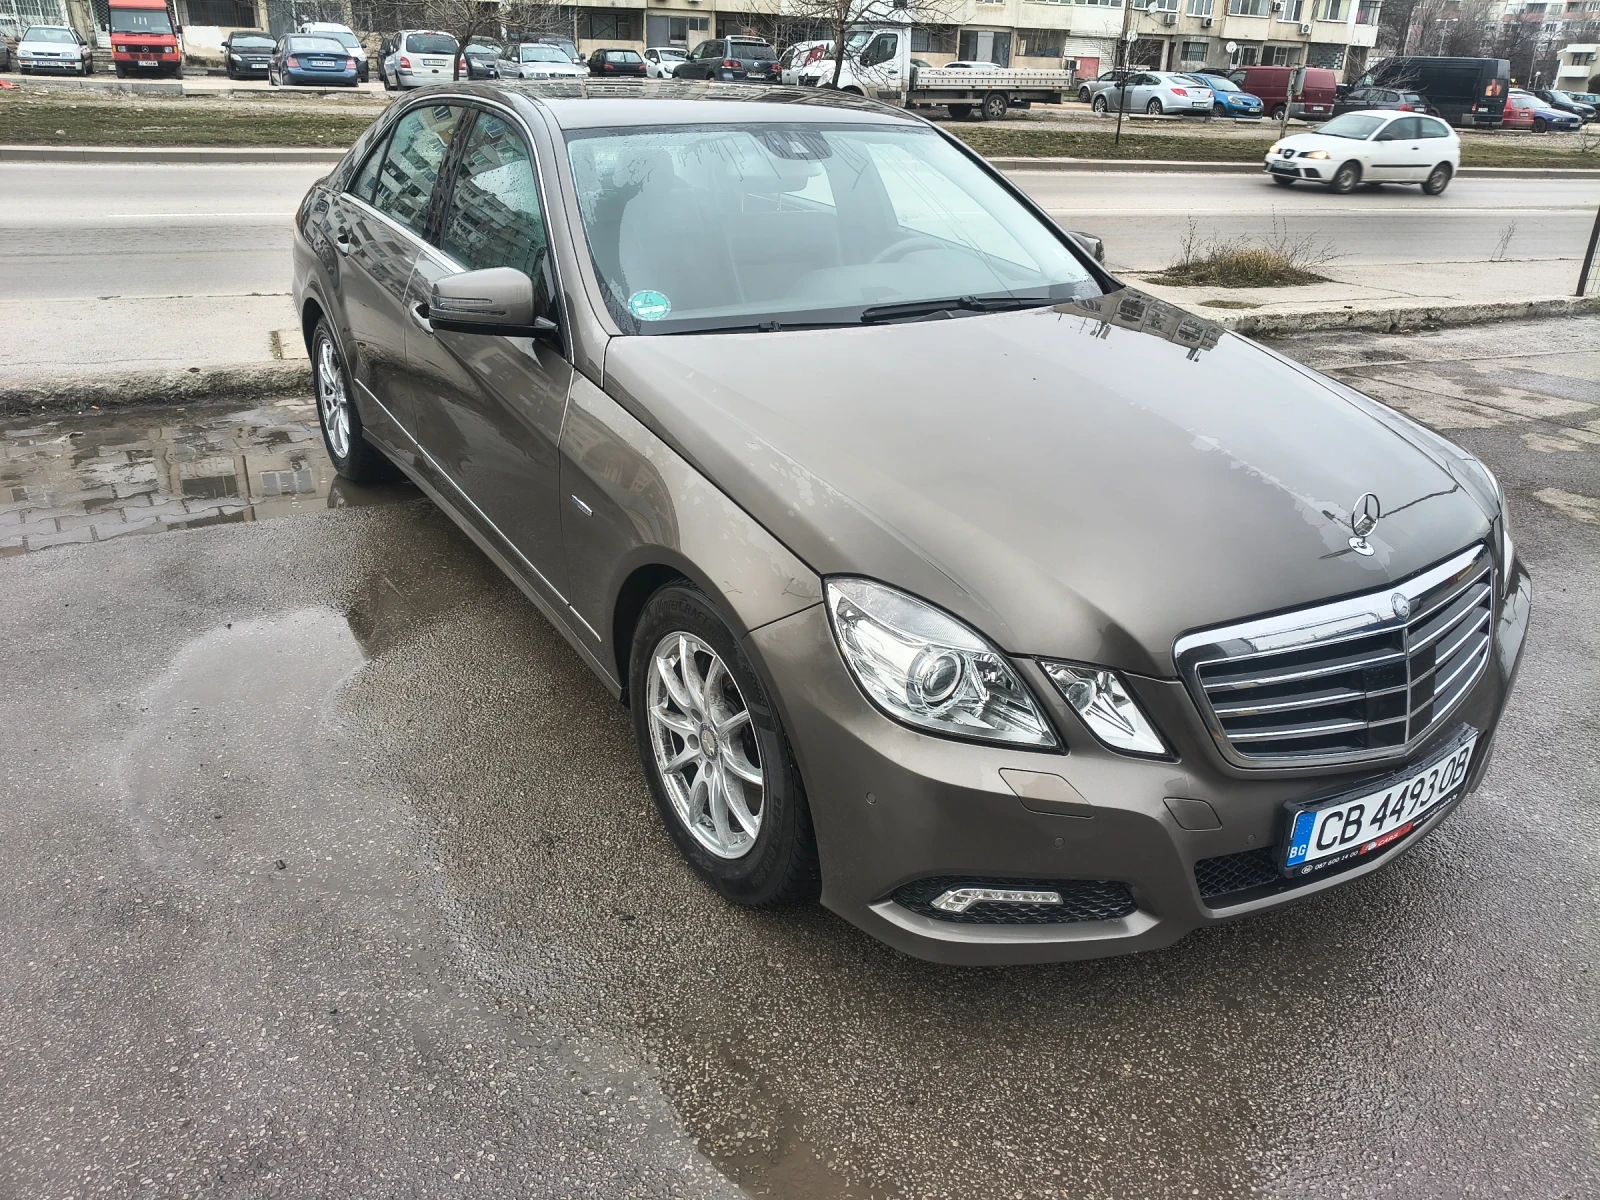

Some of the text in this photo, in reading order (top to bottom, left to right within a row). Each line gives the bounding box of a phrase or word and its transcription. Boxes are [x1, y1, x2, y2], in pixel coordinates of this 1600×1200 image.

[1316, 803, 1366, 851] CB
[1370, 769, 1439, 831] 4493
[1377, 832, 1399, 846] CARS
[1290, 844, 1308, 858] BG
